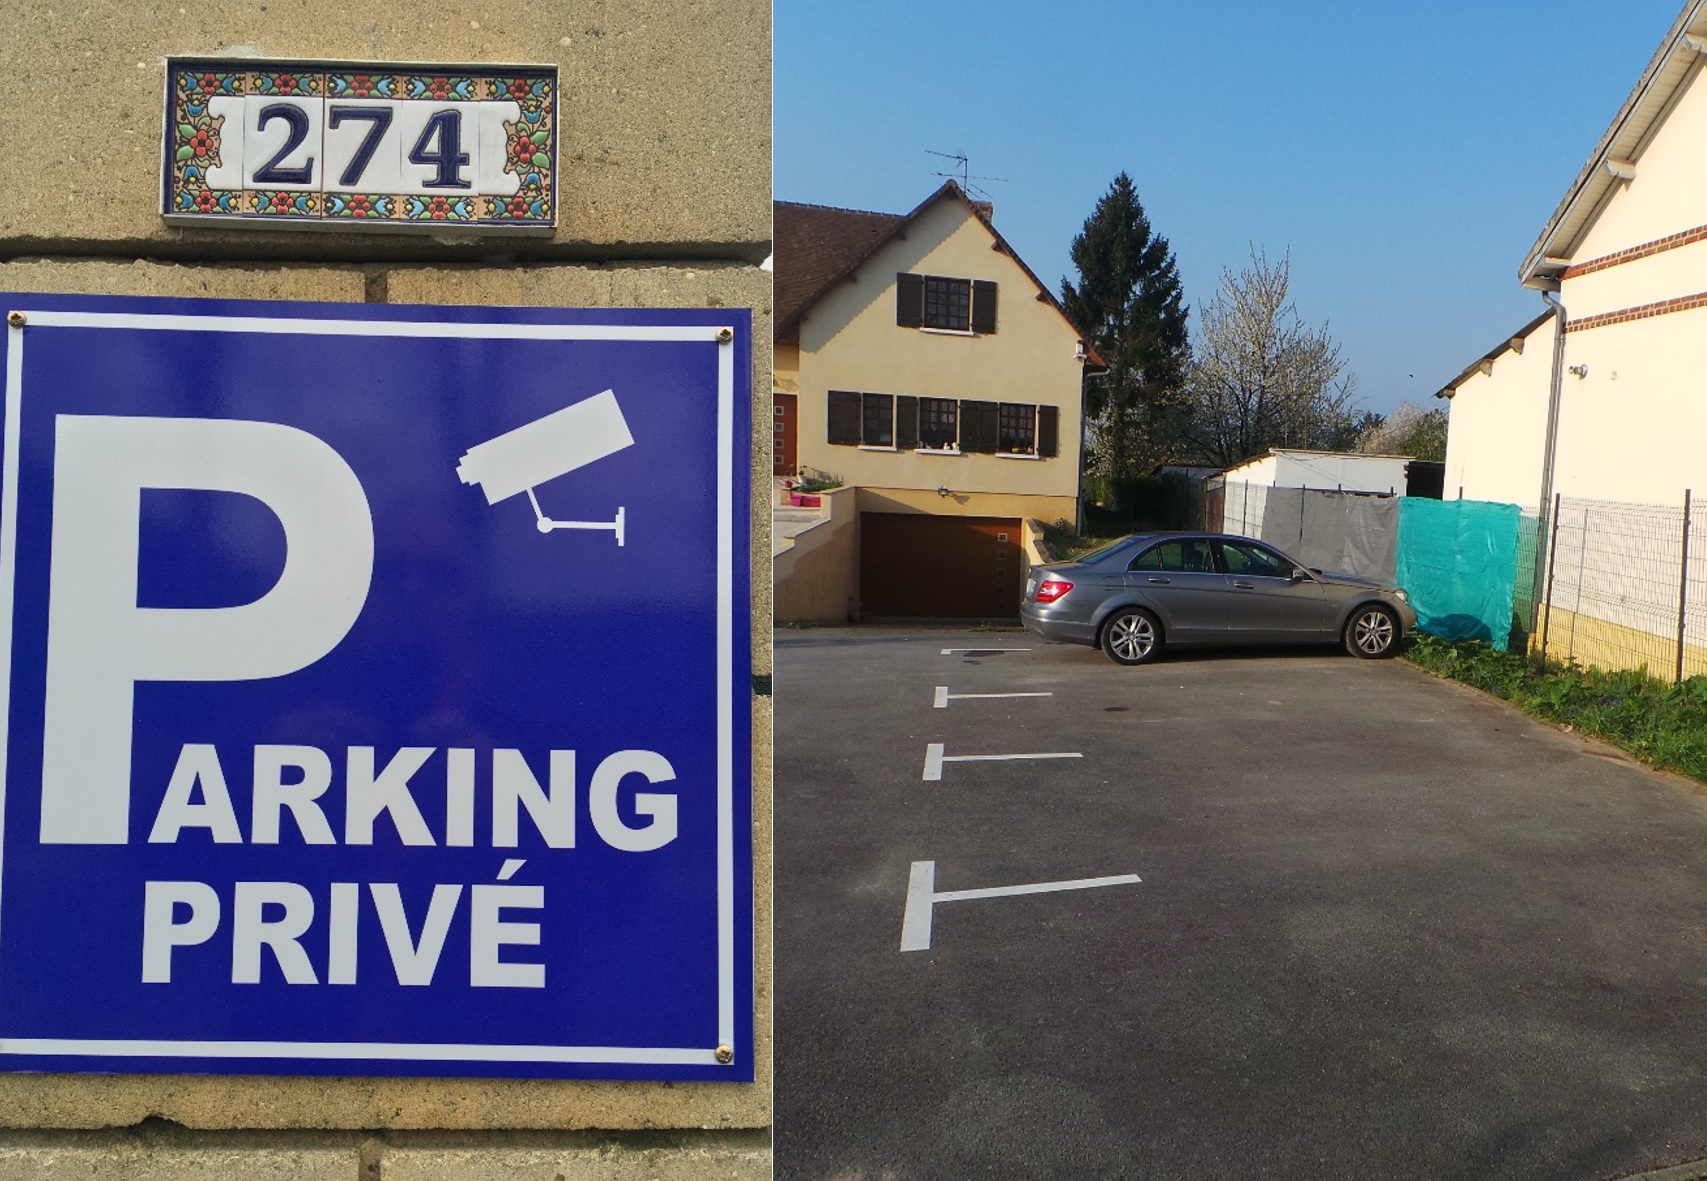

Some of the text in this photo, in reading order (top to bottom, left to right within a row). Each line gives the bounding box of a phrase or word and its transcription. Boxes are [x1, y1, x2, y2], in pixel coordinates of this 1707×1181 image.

[252, 103, 472, 189] 274
[39, 413, 679, 852] PARKING
[141, 859, 546, 989] PRIVÉ
